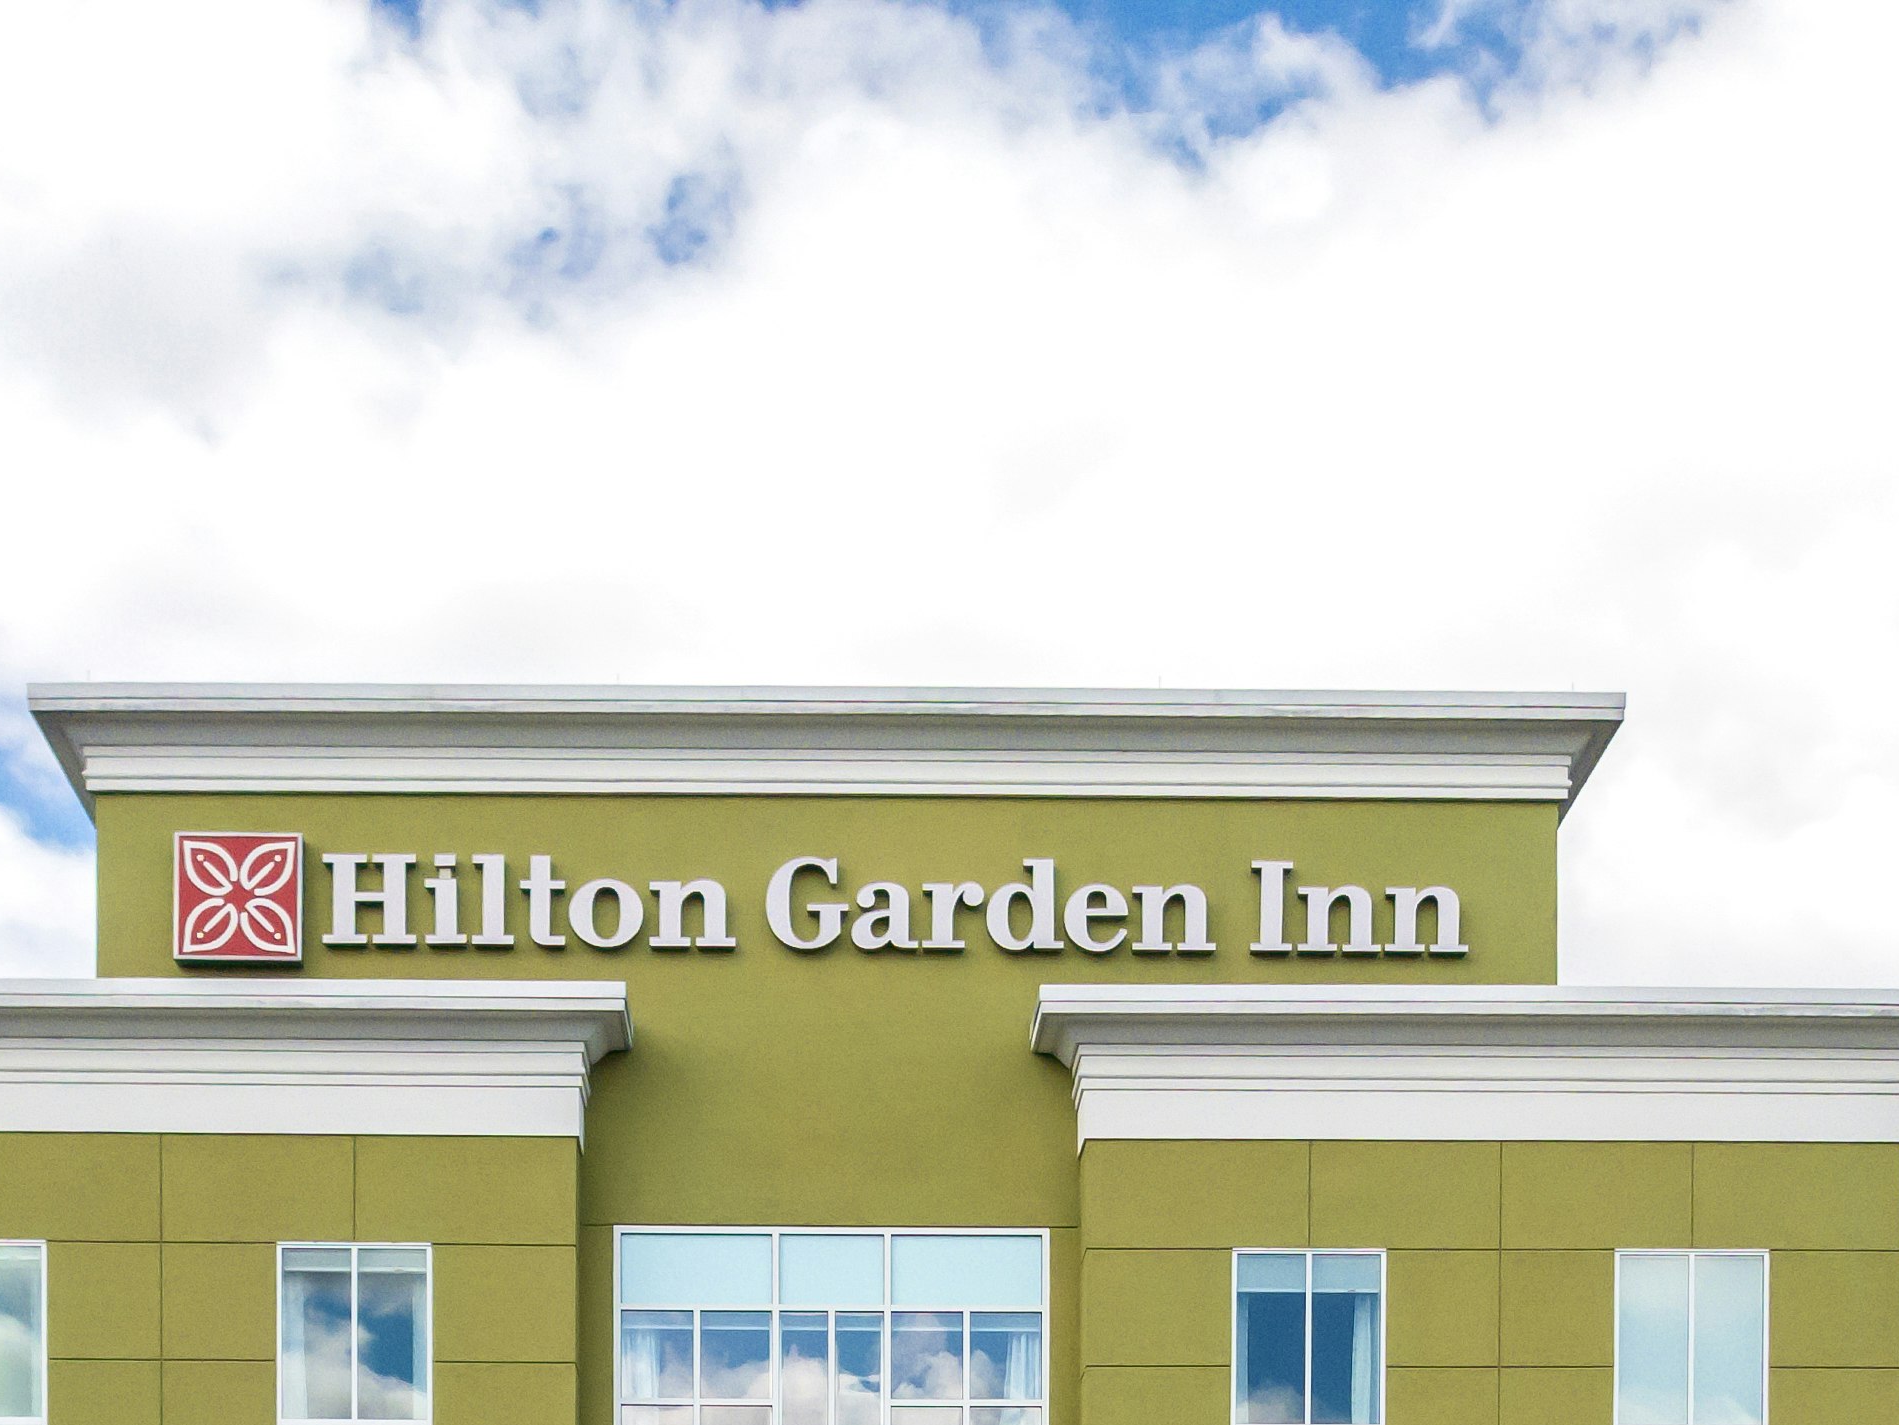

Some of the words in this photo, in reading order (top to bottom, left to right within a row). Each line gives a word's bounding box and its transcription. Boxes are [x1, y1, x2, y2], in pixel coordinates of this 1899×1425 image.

[322, 853, 737, 948] Hilton
[765, 856, 1217, 952] Garden
[1249, 859, 1469, 953] Inn
